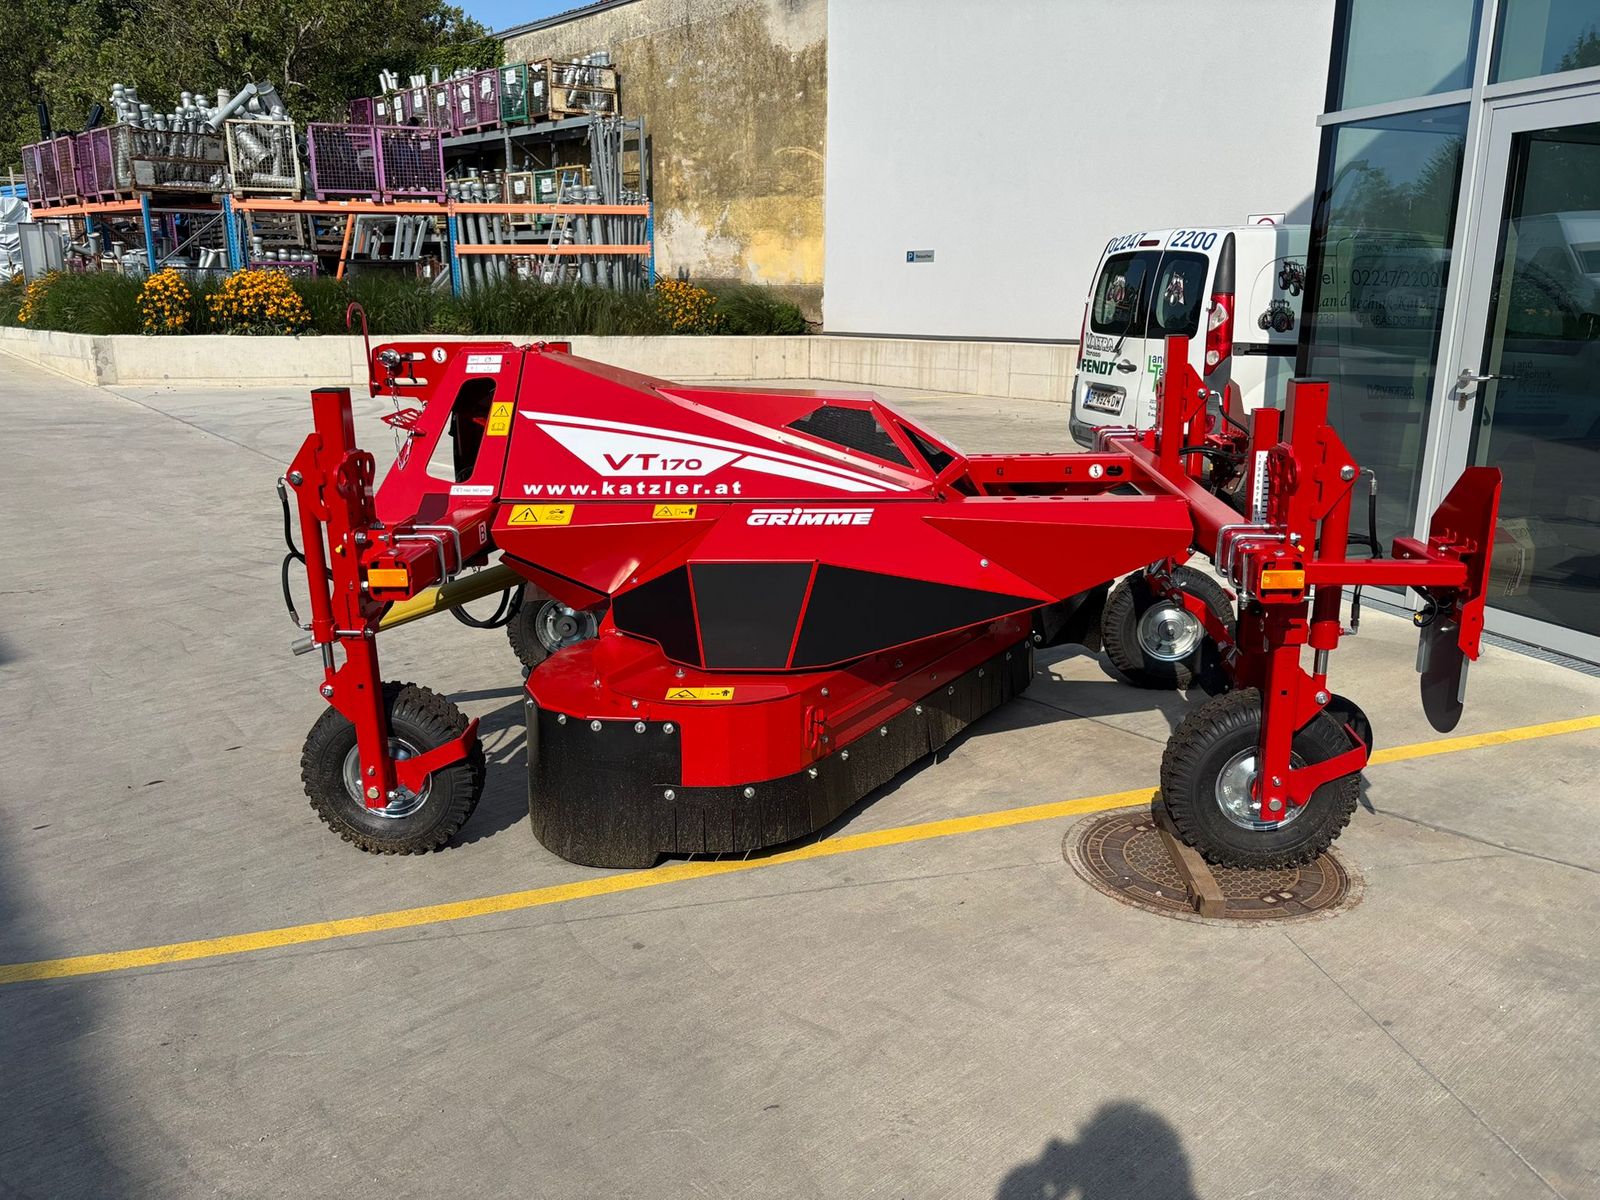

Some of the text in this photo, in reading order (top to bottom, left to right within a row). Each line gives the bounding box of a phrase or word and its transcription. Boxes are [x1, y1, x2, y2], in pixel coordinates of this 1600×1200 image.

[1107, 230, 1218, 254] 02247 2200
[1081, 358, 1116, 376] FENDT
[523, 481, 742, 496] www.katzler.at
[746, 508, 875, 526] GRIMME
